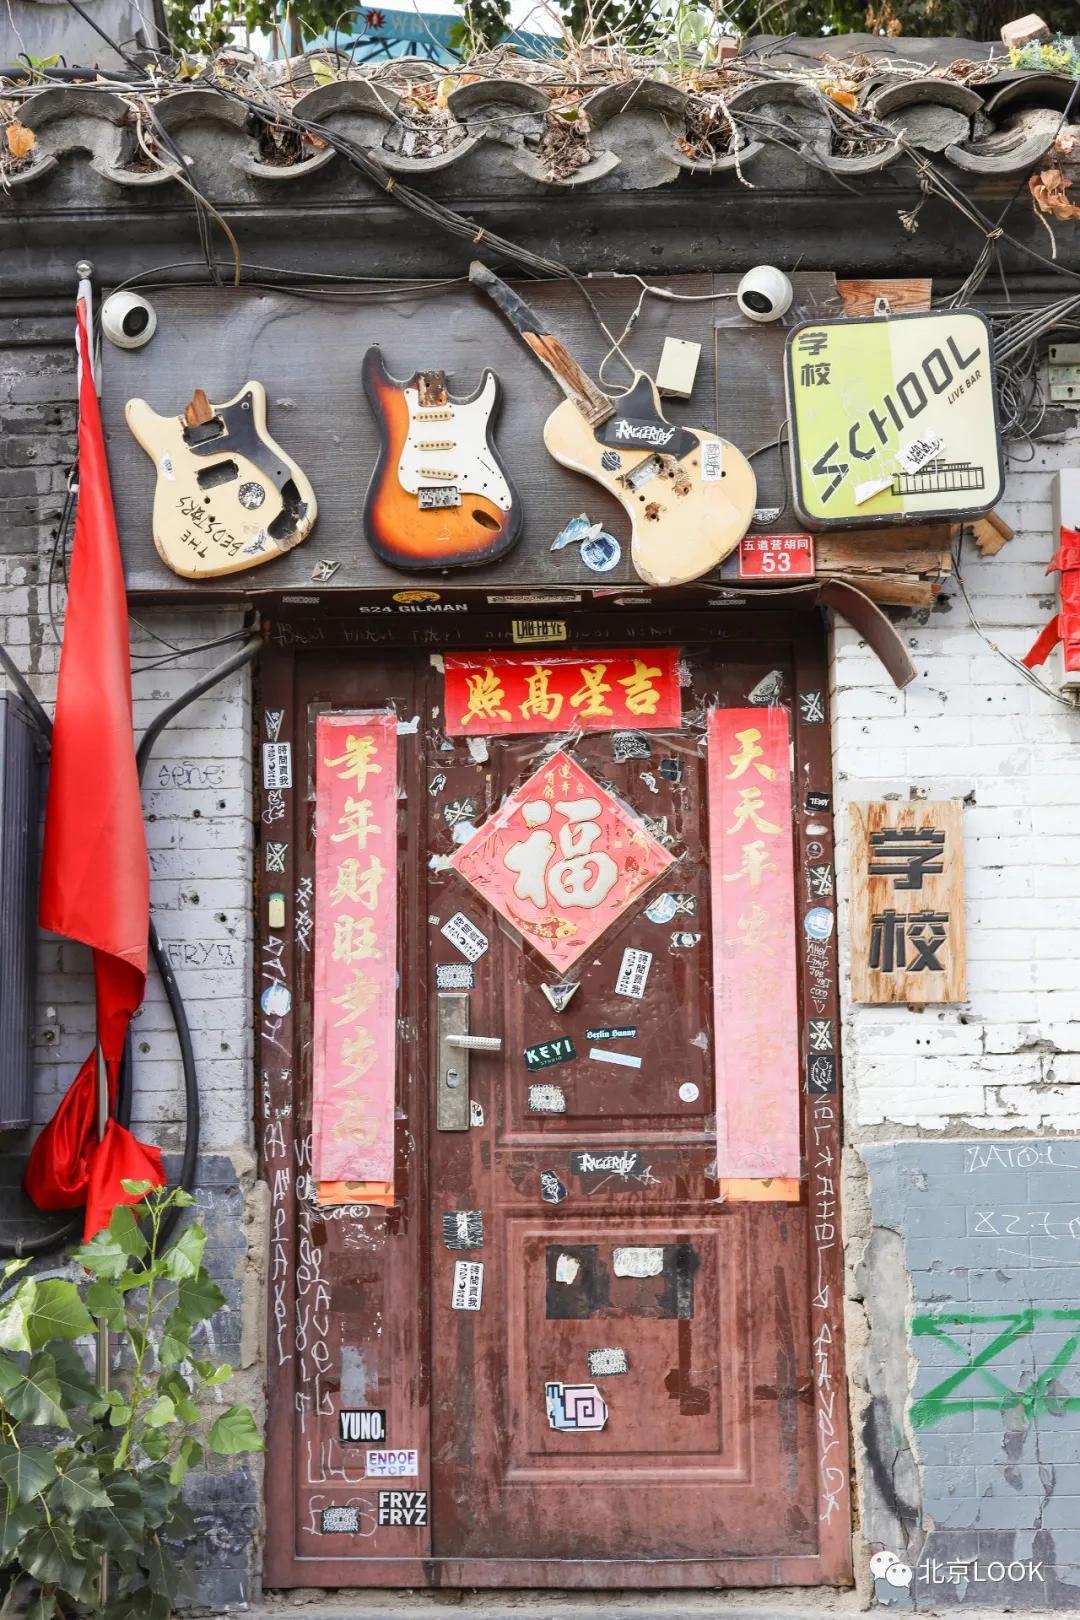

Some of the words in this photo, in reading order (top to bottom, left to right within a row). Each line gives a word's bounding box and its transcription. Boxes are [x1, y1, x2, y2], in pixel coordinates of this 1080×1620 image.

[797, 332, 832, 388] 学校
[947, 384, 966, 405] LIVE
[965, 369, 982, 389] BAR
[811, 335, 982, 504] SCHOOL
[180, 529, 209, 559] THE
[743, 539, 809, 551] 五道营胡同
[761, 552, 791, 573] 53
[398, 603, 468, 613] GILMAN
[503, 797, 620, 910] 福
[867, 828, 950, 973] 学校
[526, 1039, 572, 1064] KEYI
[378, 1492, 427, 1509] FRYZ
[378, 1508, 427, 1526] FRYZ
